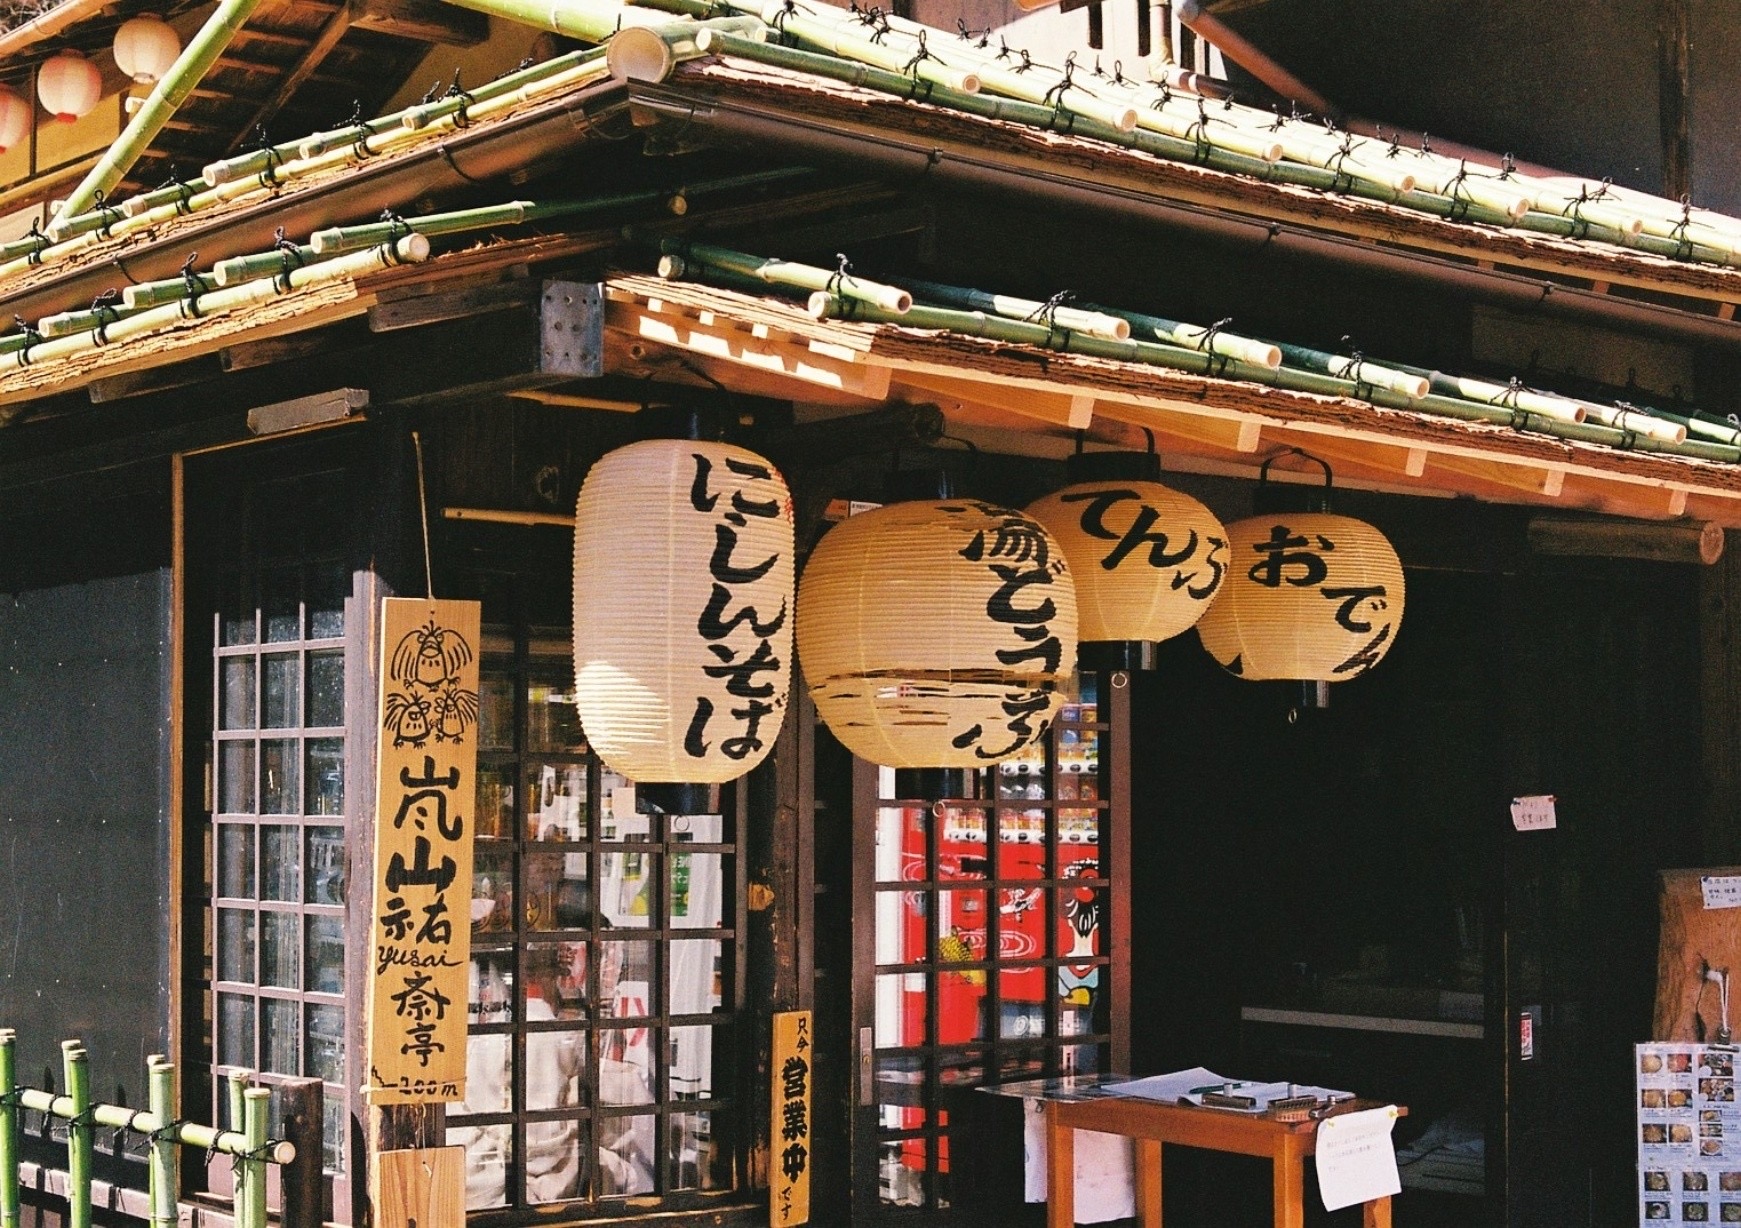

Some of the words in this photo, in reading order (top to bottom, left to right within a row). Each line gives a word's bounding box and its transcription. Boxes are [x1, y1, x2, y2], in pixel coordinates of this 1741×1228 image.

[685, 453, 788, 759] にしんそば
